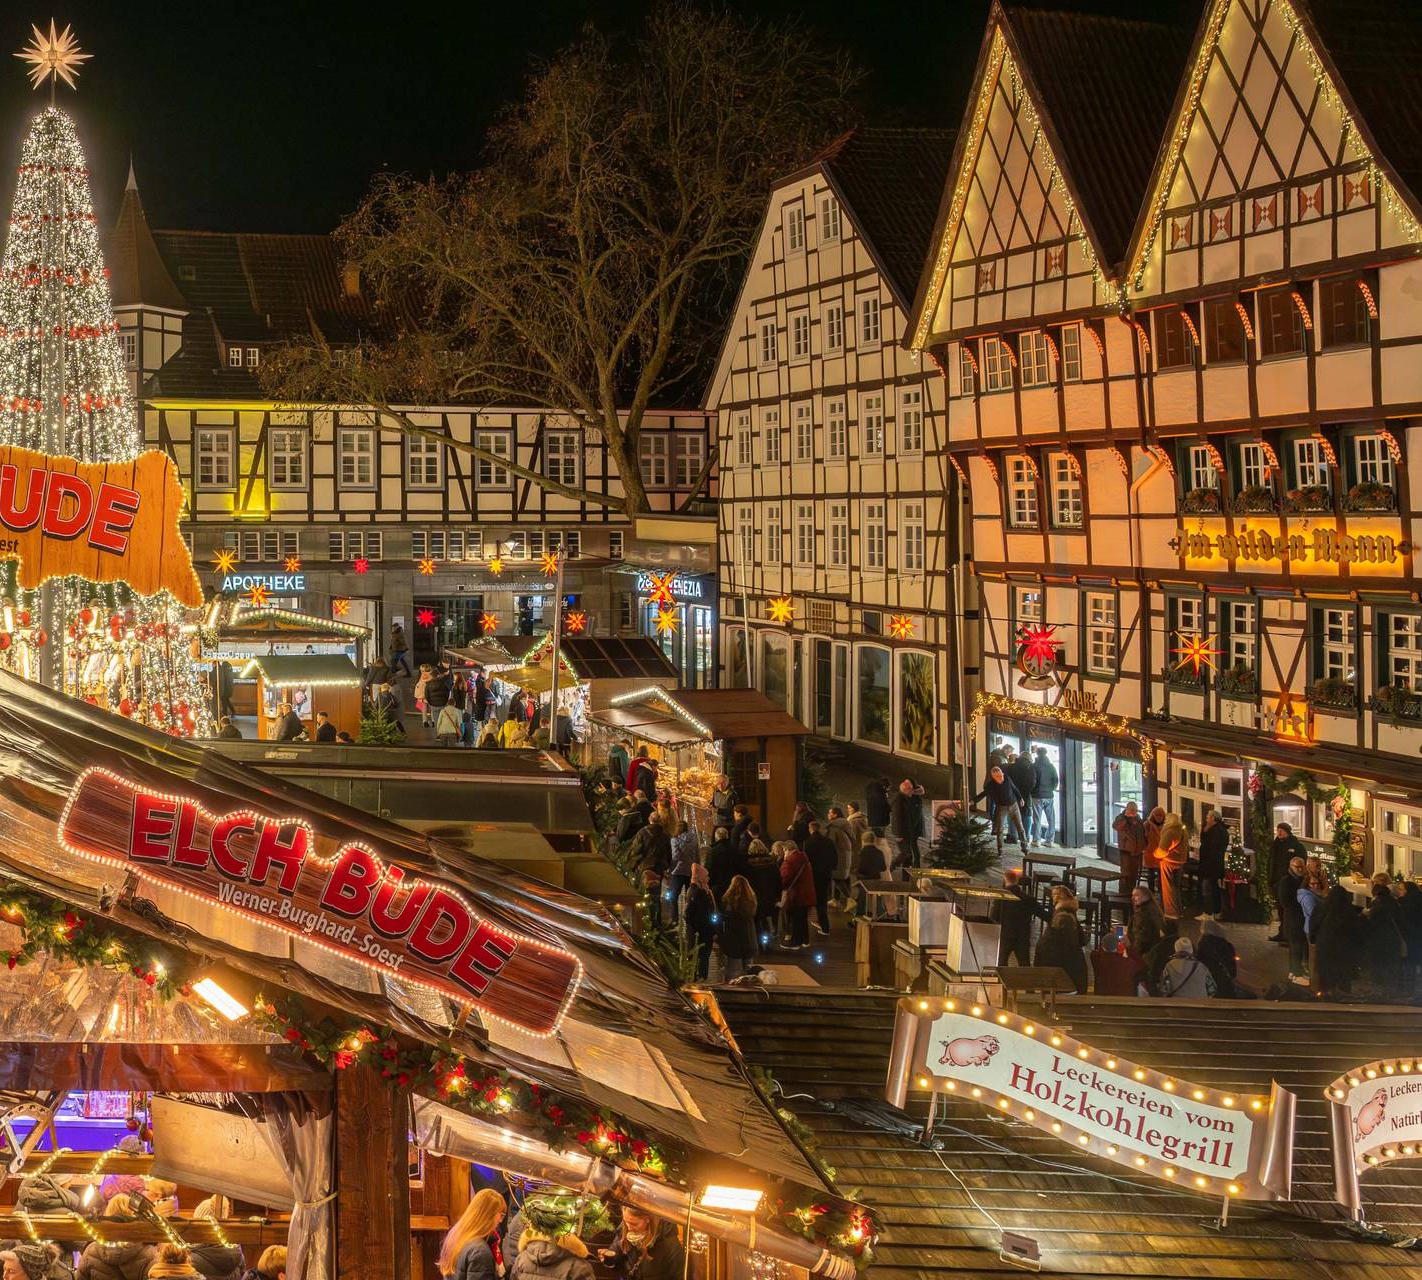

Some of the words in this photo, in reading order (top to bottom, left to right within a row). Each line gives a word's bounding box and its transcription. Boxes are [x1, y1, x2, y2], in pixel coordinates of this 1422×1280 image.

[222, 576, 306, 591] APOTHEKE
[1312, 528, 1397, 563] Mann
[1063, 688, 1098, 711] RAABE
[130, 792, 310, 894] ELCH
[321, 847, 517, 996] BUDE
[218, 882, 277, 914] Werner
[359, 934, 404, 971] Soest
[1009, 1062, 1234, 1168] Holzkohlegrill
[1051, 1054, 1173, 1118] Leckereien
[1185, 1111, 1234, 1133] vom
